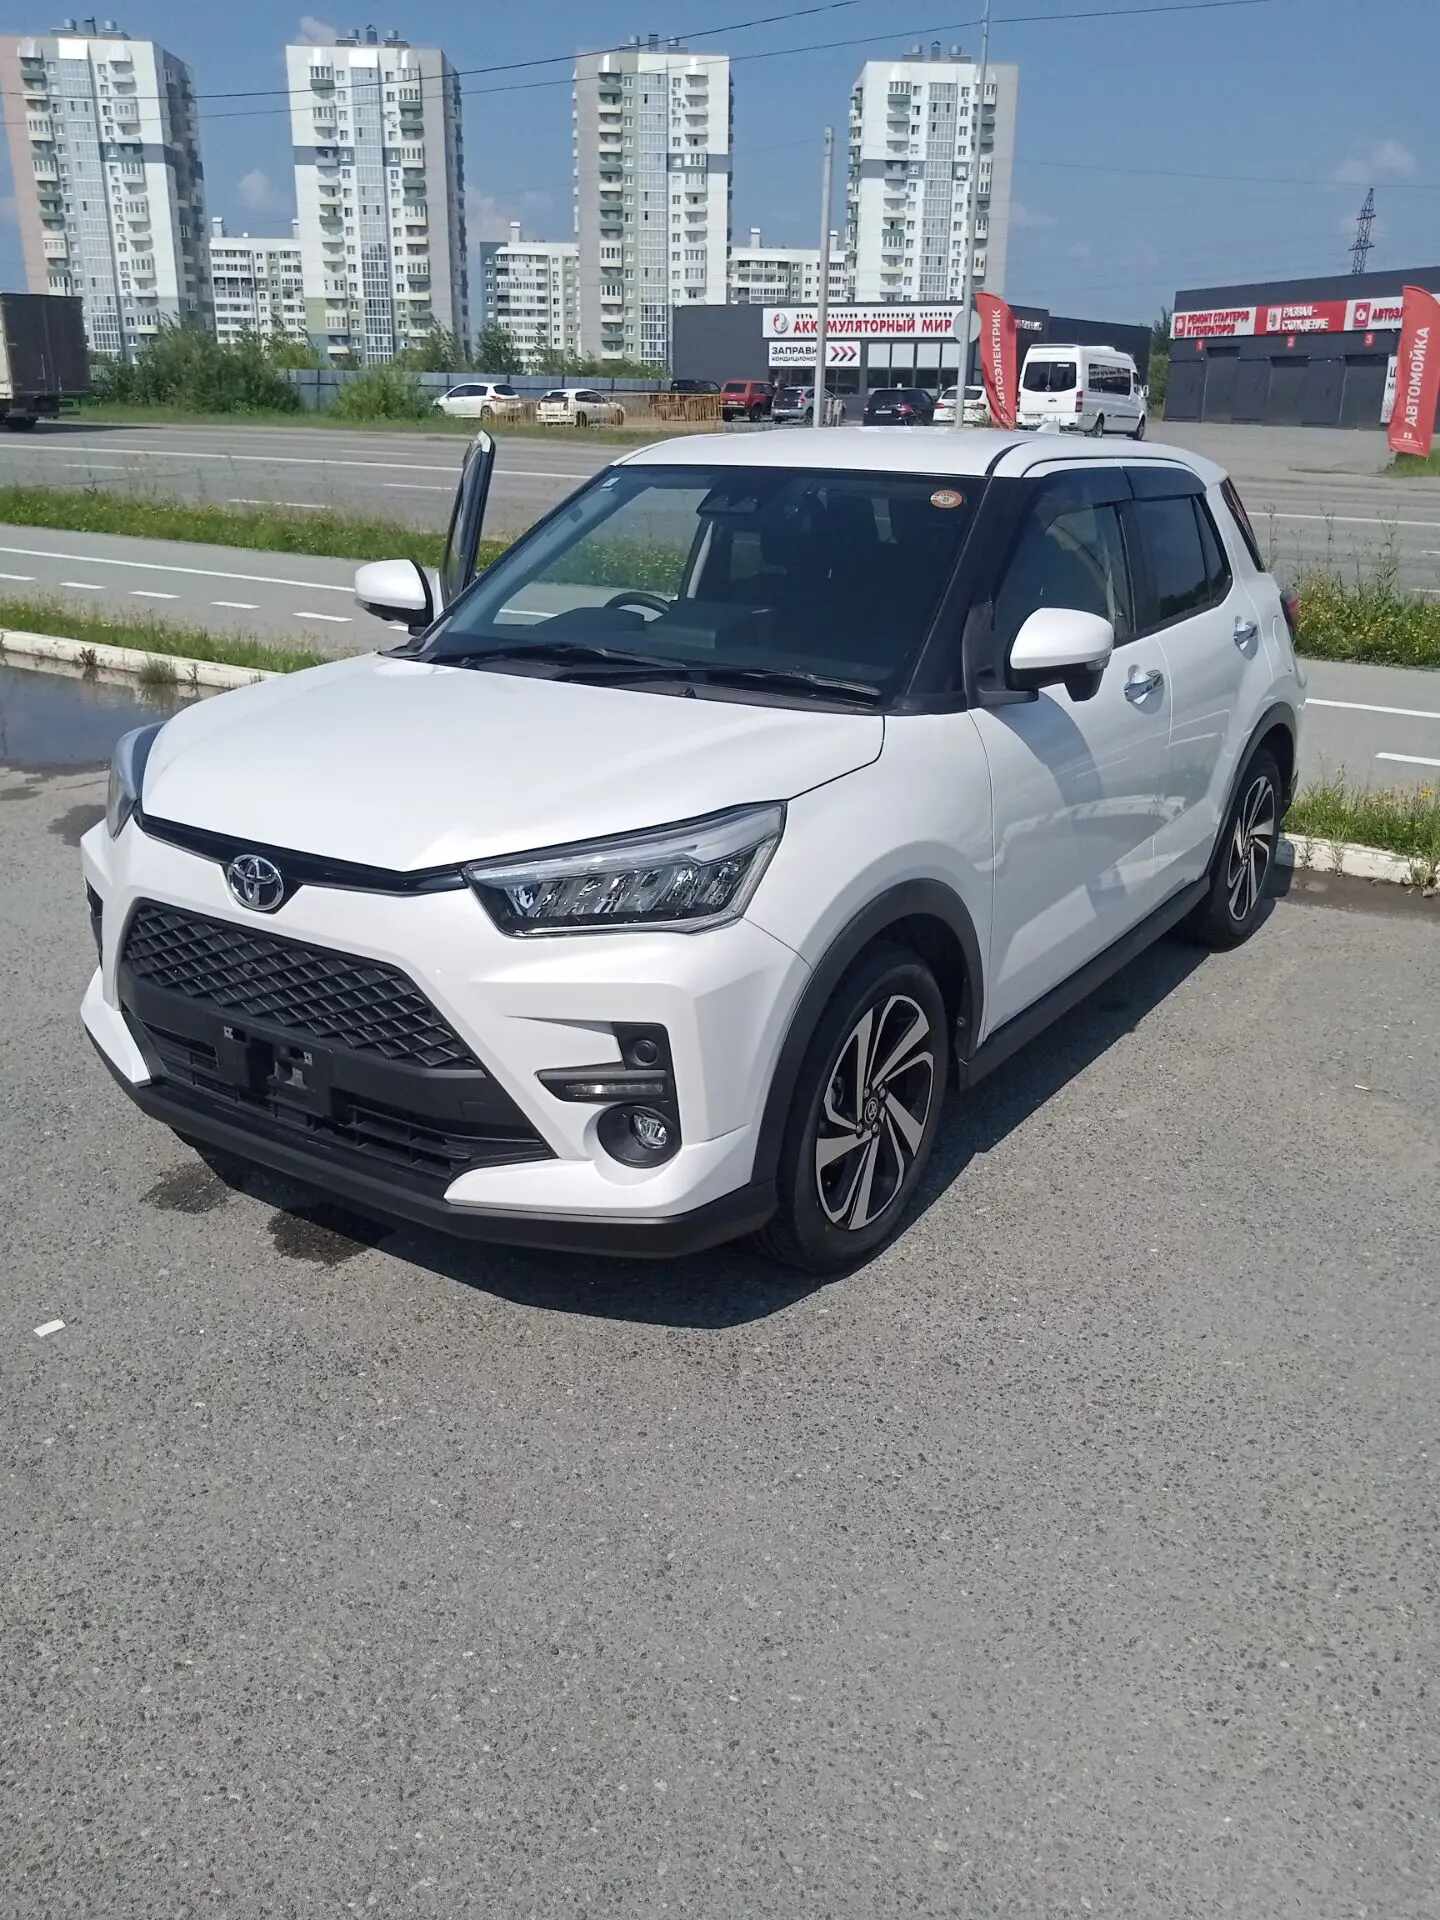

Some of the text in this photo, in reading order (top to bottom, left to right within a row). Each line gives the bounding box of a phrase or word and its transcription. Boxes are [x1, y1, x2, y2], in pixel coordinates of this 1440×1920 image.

[793, 318, 952, 334] АККМУЛЯТОРНЫЙ МИР
[1404, 327, 1430, 427] АВТОМОЙКА
